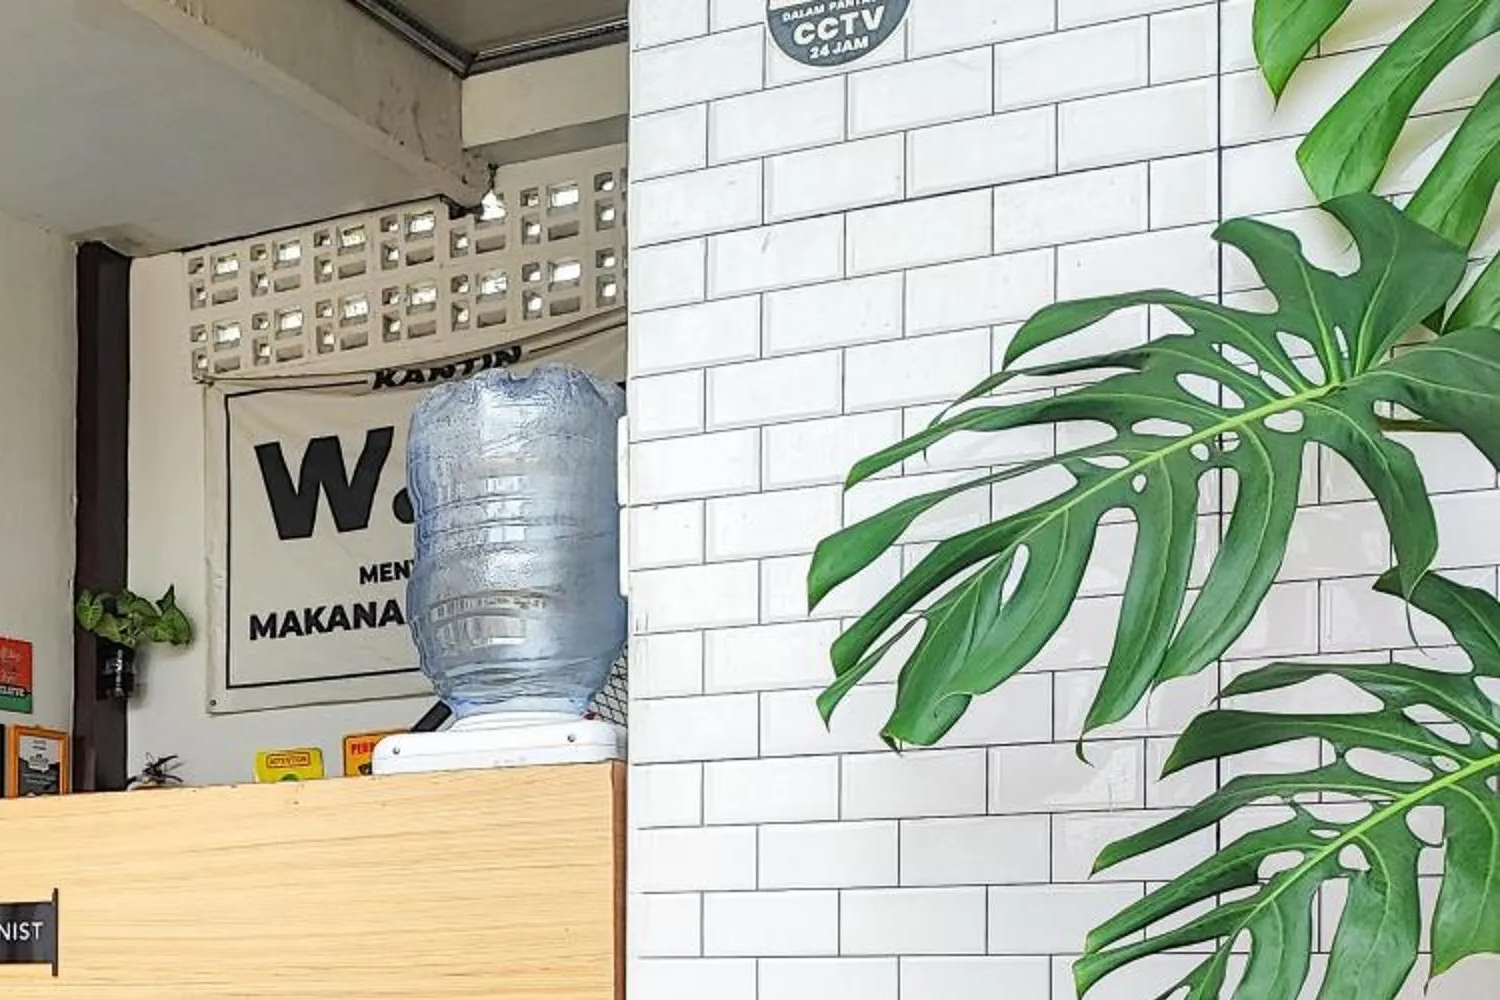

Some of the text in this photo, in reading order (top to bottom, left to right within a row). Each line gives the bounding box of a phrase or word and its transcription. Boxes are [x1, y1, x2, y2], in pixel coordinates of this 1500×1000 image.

[782, 4, 825, 22] DALAM
[793, 5, 886, 45] CCTV
[809, 36, 869, 59] 24 JAM
[372, 345, 523, 390] KANTIN
